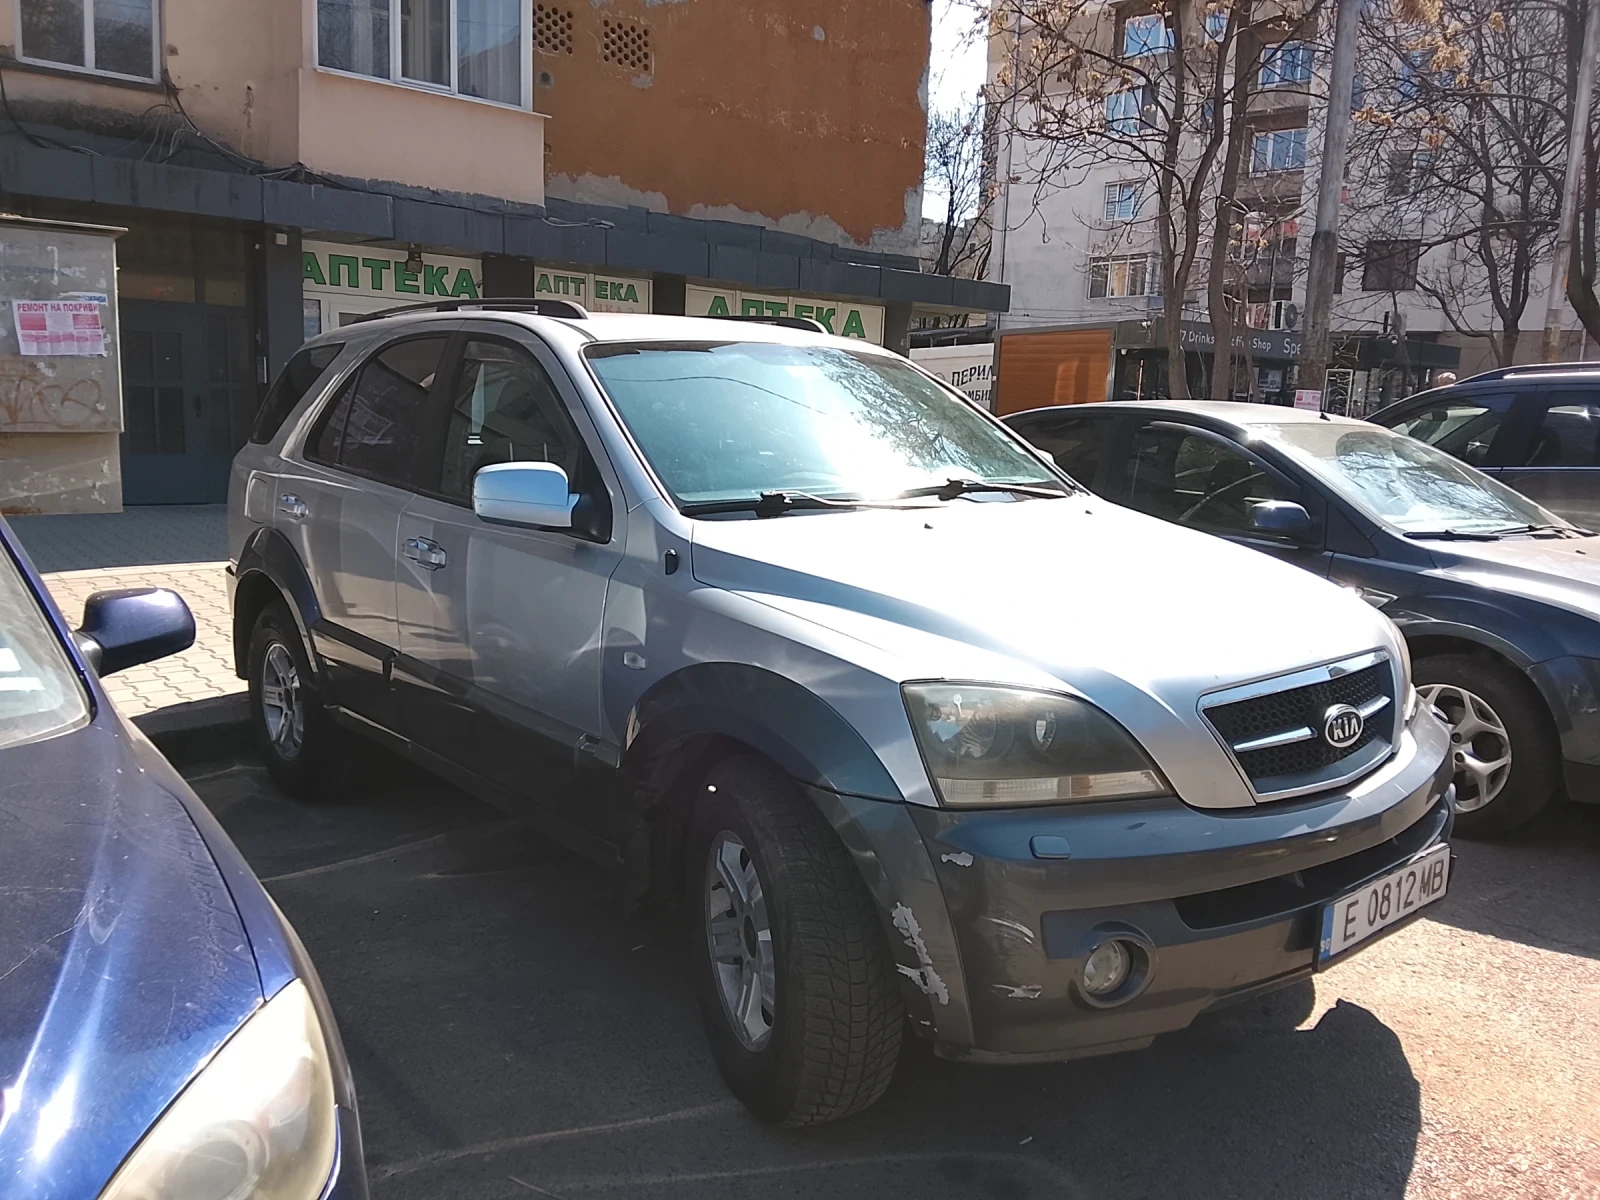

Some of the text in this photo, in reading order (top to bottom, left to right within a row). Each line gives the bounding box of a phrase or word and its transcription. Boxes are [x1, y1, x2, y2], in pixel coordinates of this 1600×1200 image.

[302, 251, 479, 298] АПТЕКА
[17, 303, 98, 312] РЕМОНТ НА ПОКРИВИ
[1188, 331, 1215, 344] Drinks
[1252, 338, 1272, 352] Shop
[1332, 714, 1359, 740] KIA
[1343, 858, 1445, 942] E 0812 MB
